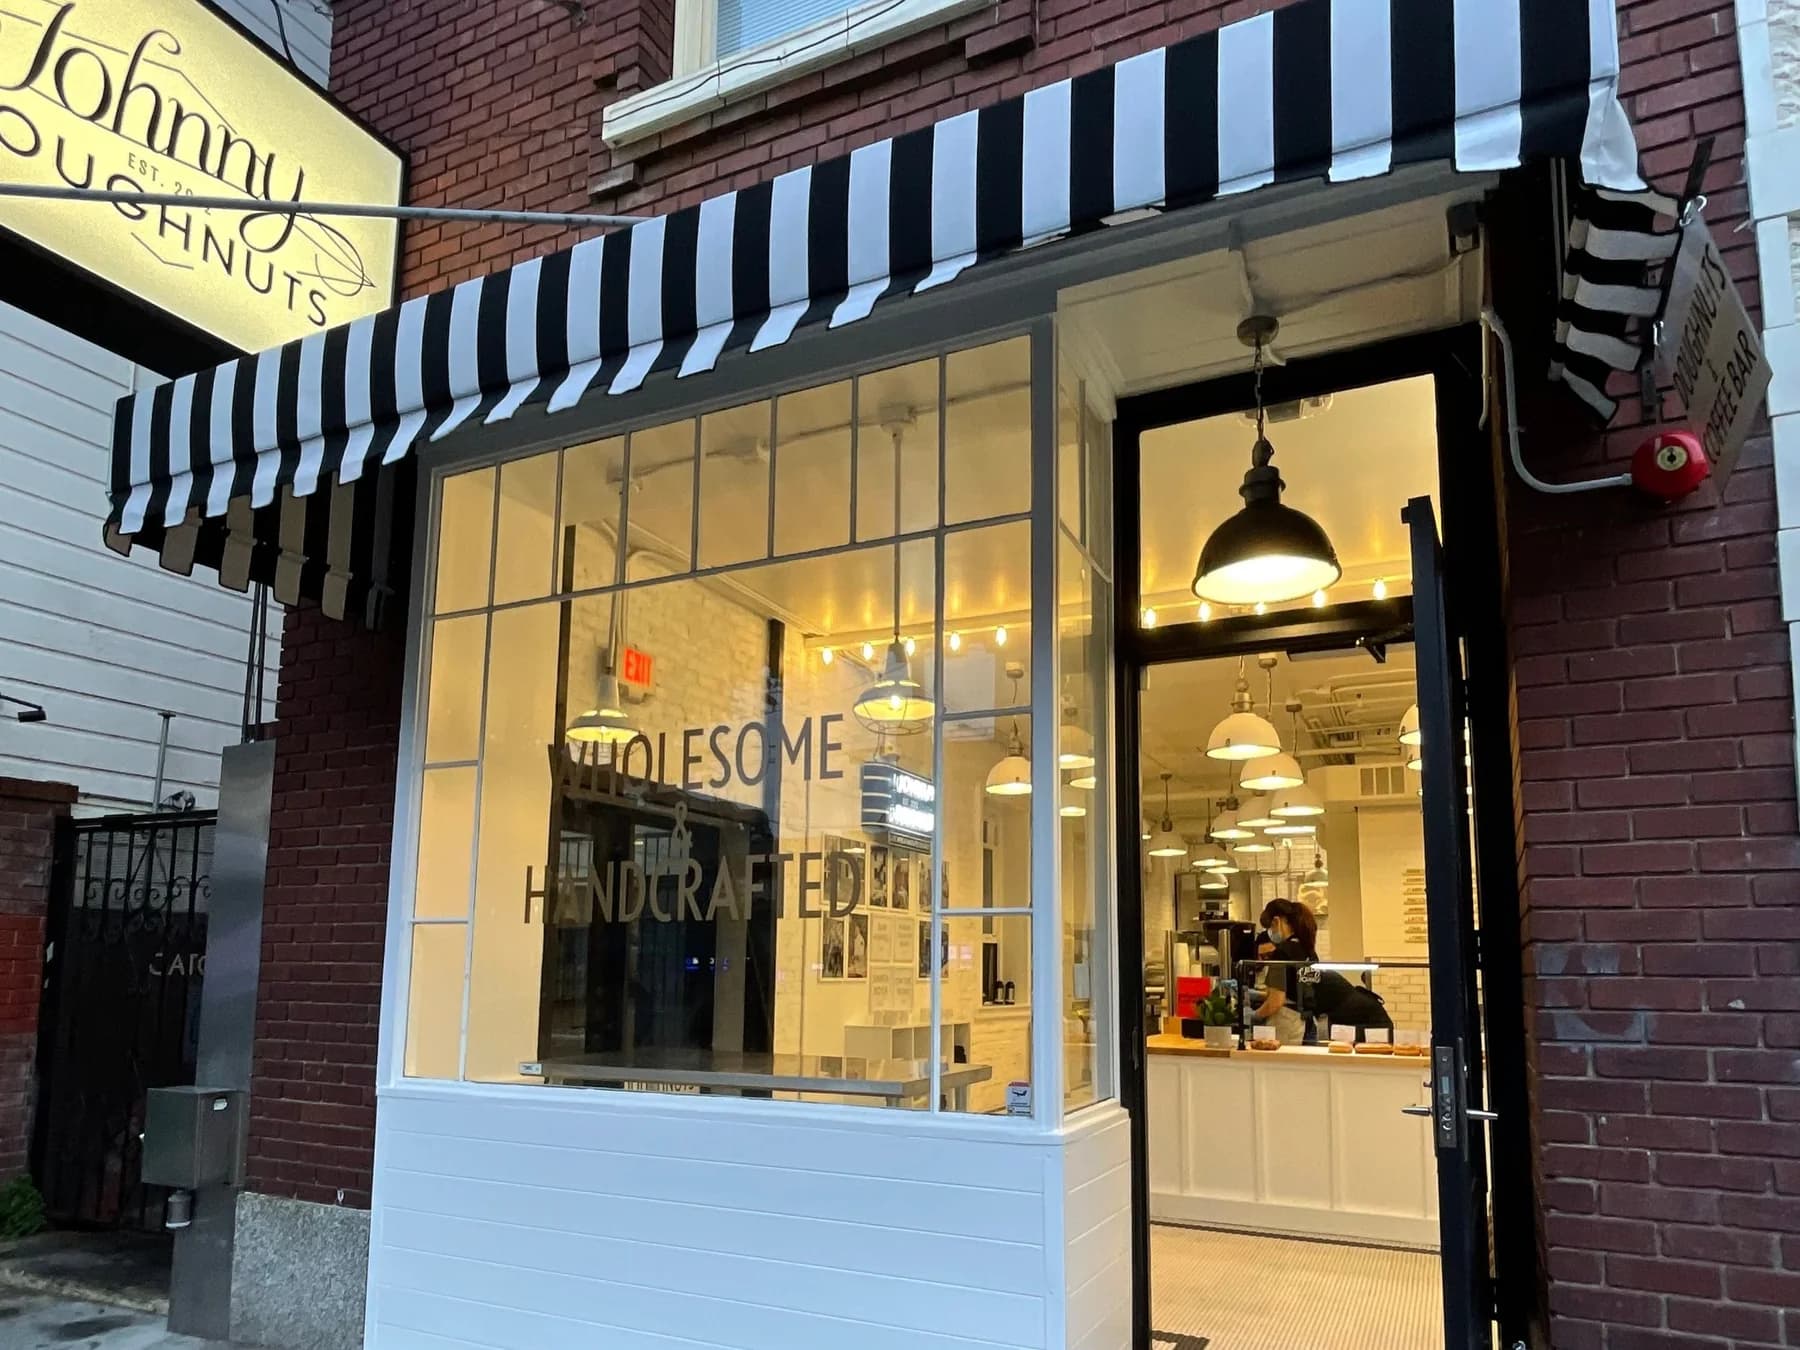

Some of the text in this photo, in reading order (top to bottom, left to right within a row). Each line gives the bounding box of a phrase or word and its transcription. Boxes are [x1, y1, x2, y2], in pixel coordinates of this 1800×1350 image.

[0, 2, 305, 253] Johnny
[1672, 242, 1726, 411] DOUGHNUTS
[1702, 329, 1758, 465] COFFEE BAR
[625, 649, 653, 688] EXIT
[547, 713, 844, 798] WHOLESOME
[524, 850, 863, 925] HANDCRAFTED
